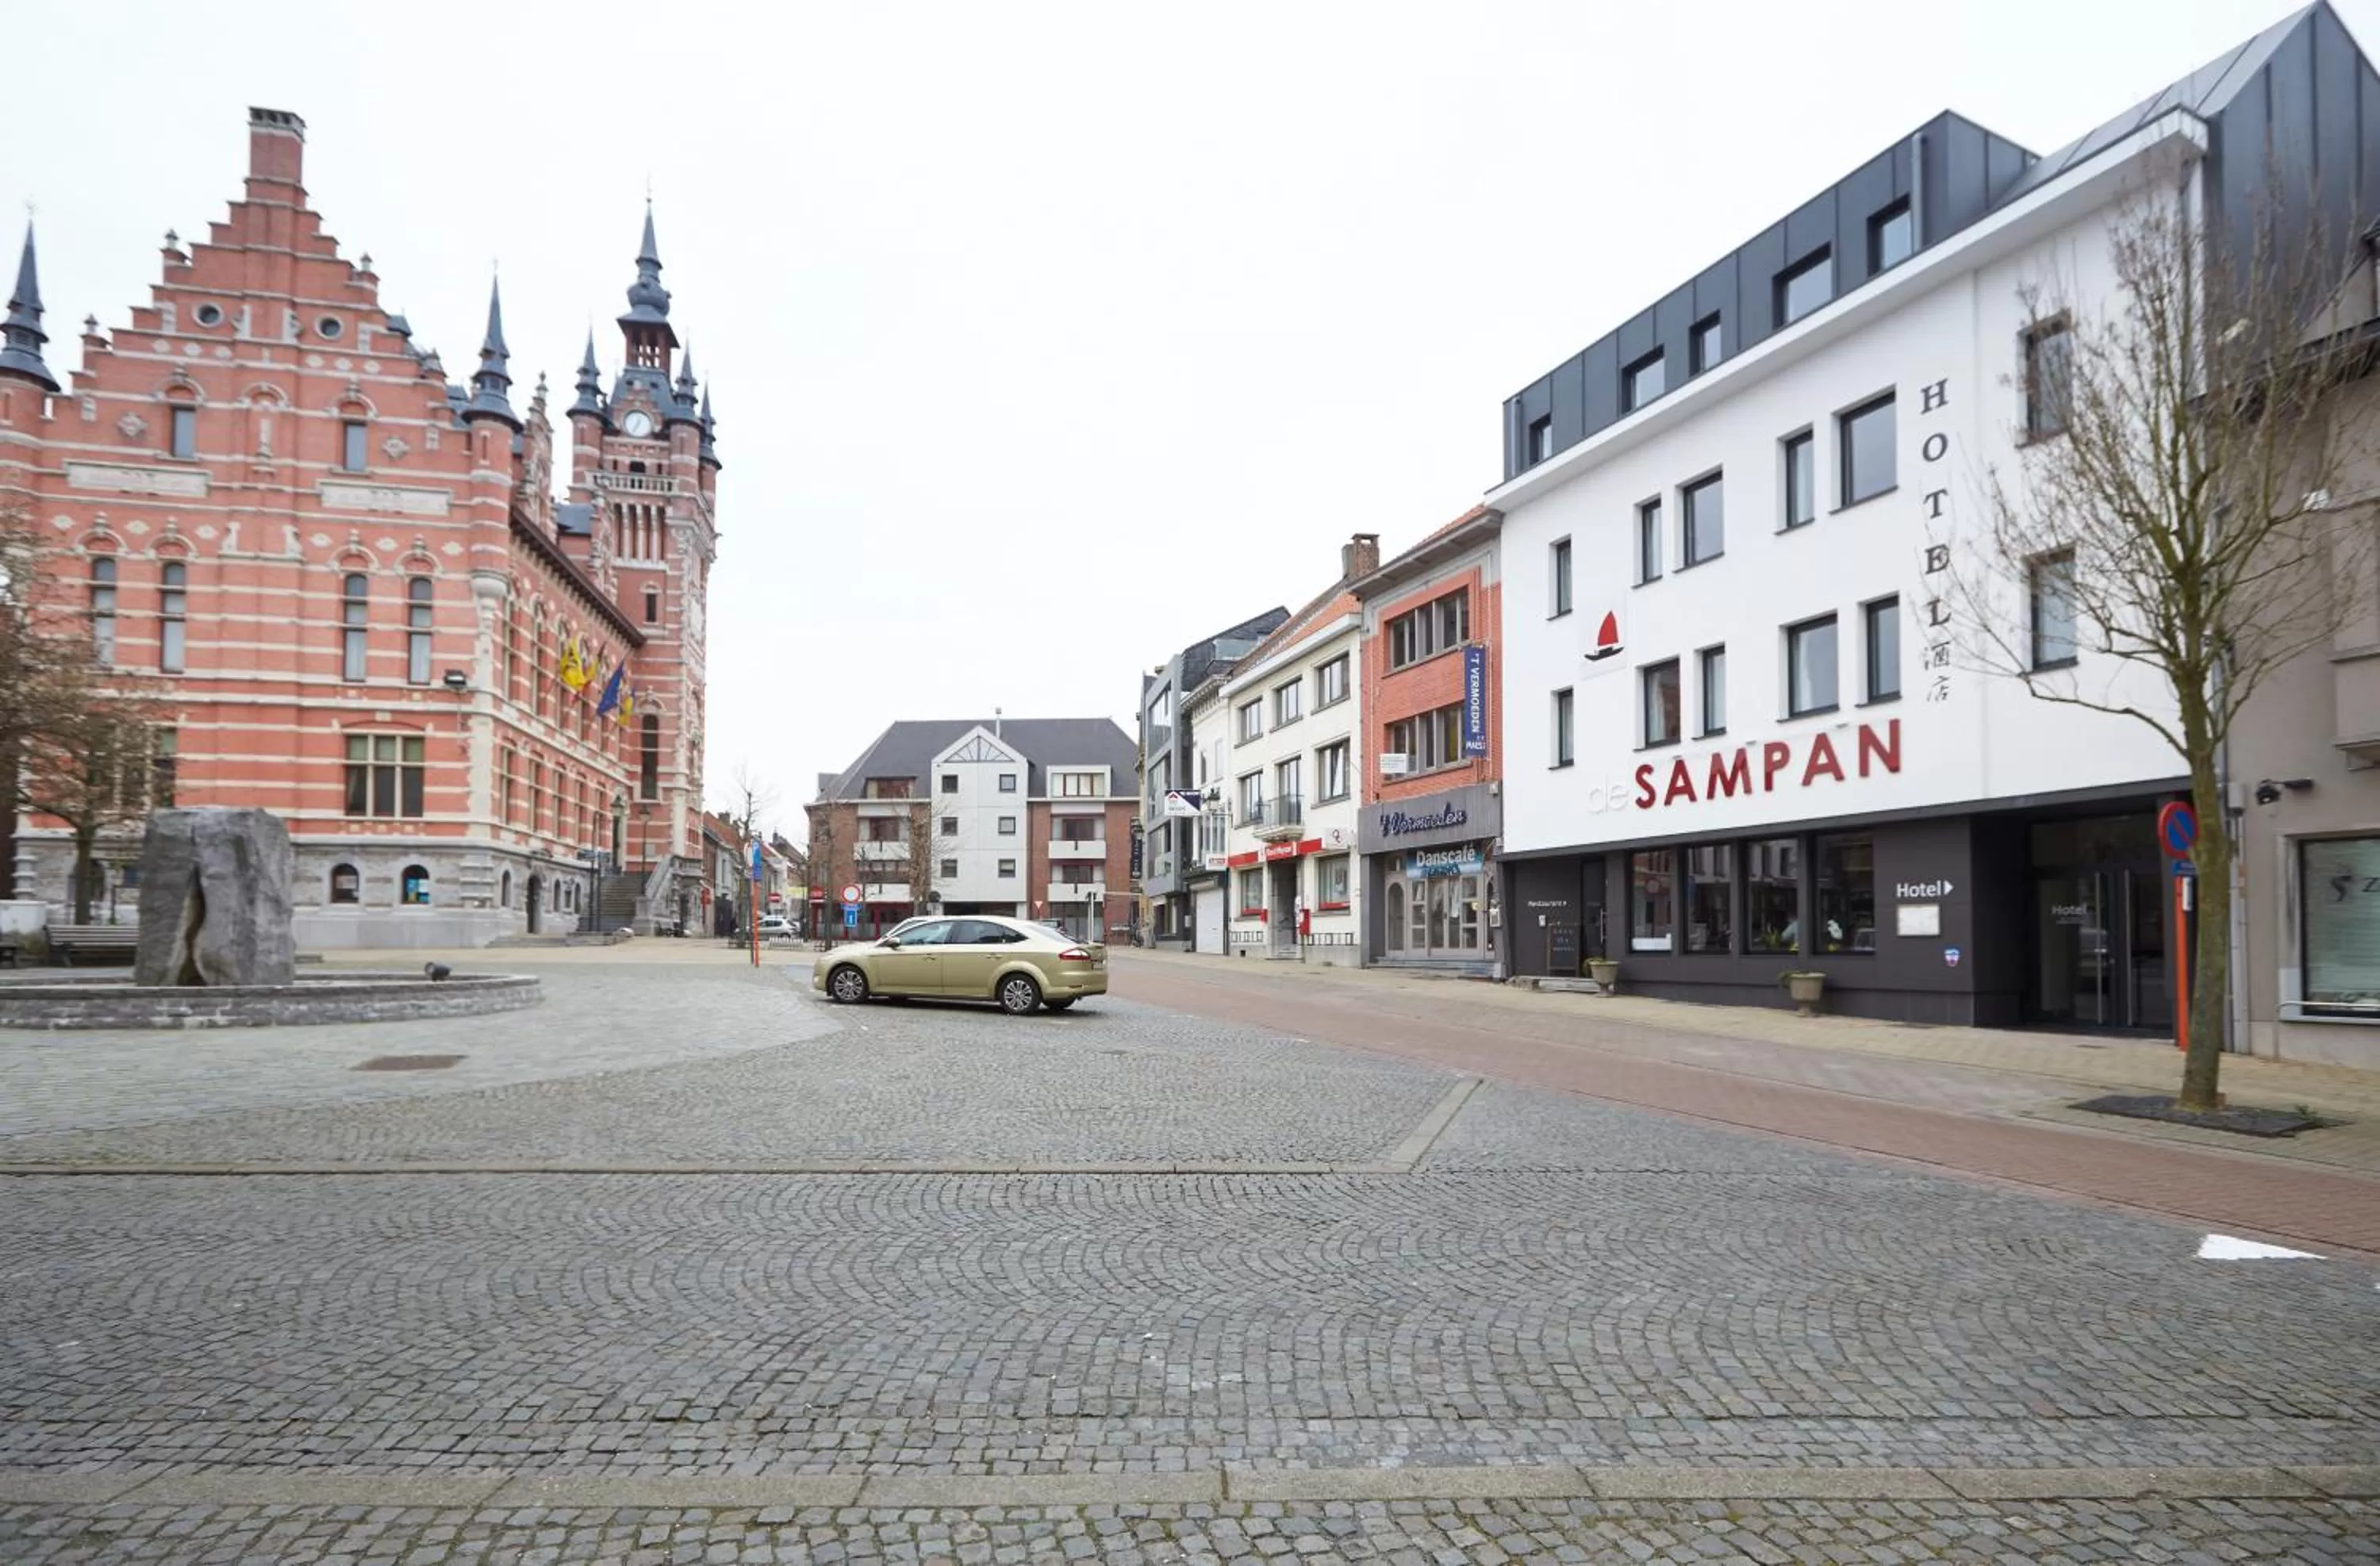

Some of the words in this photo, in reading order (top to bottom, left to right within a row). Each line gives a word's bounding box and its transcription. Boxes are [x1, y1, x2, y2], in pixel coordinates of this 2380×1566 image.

[1921, 378, 1950, 628] HOTEL
[1470, 667, 1480, 732] VERMOEDEN
[1587, 773, 1630, 813] de
[1635, 719, 1901, 809] SAMPAN
[1416, 843, 1476, 866] Danscafé
[1897, 881, 1941, 897] Hotel
[2052, 903, 2087, 915] Hotel
